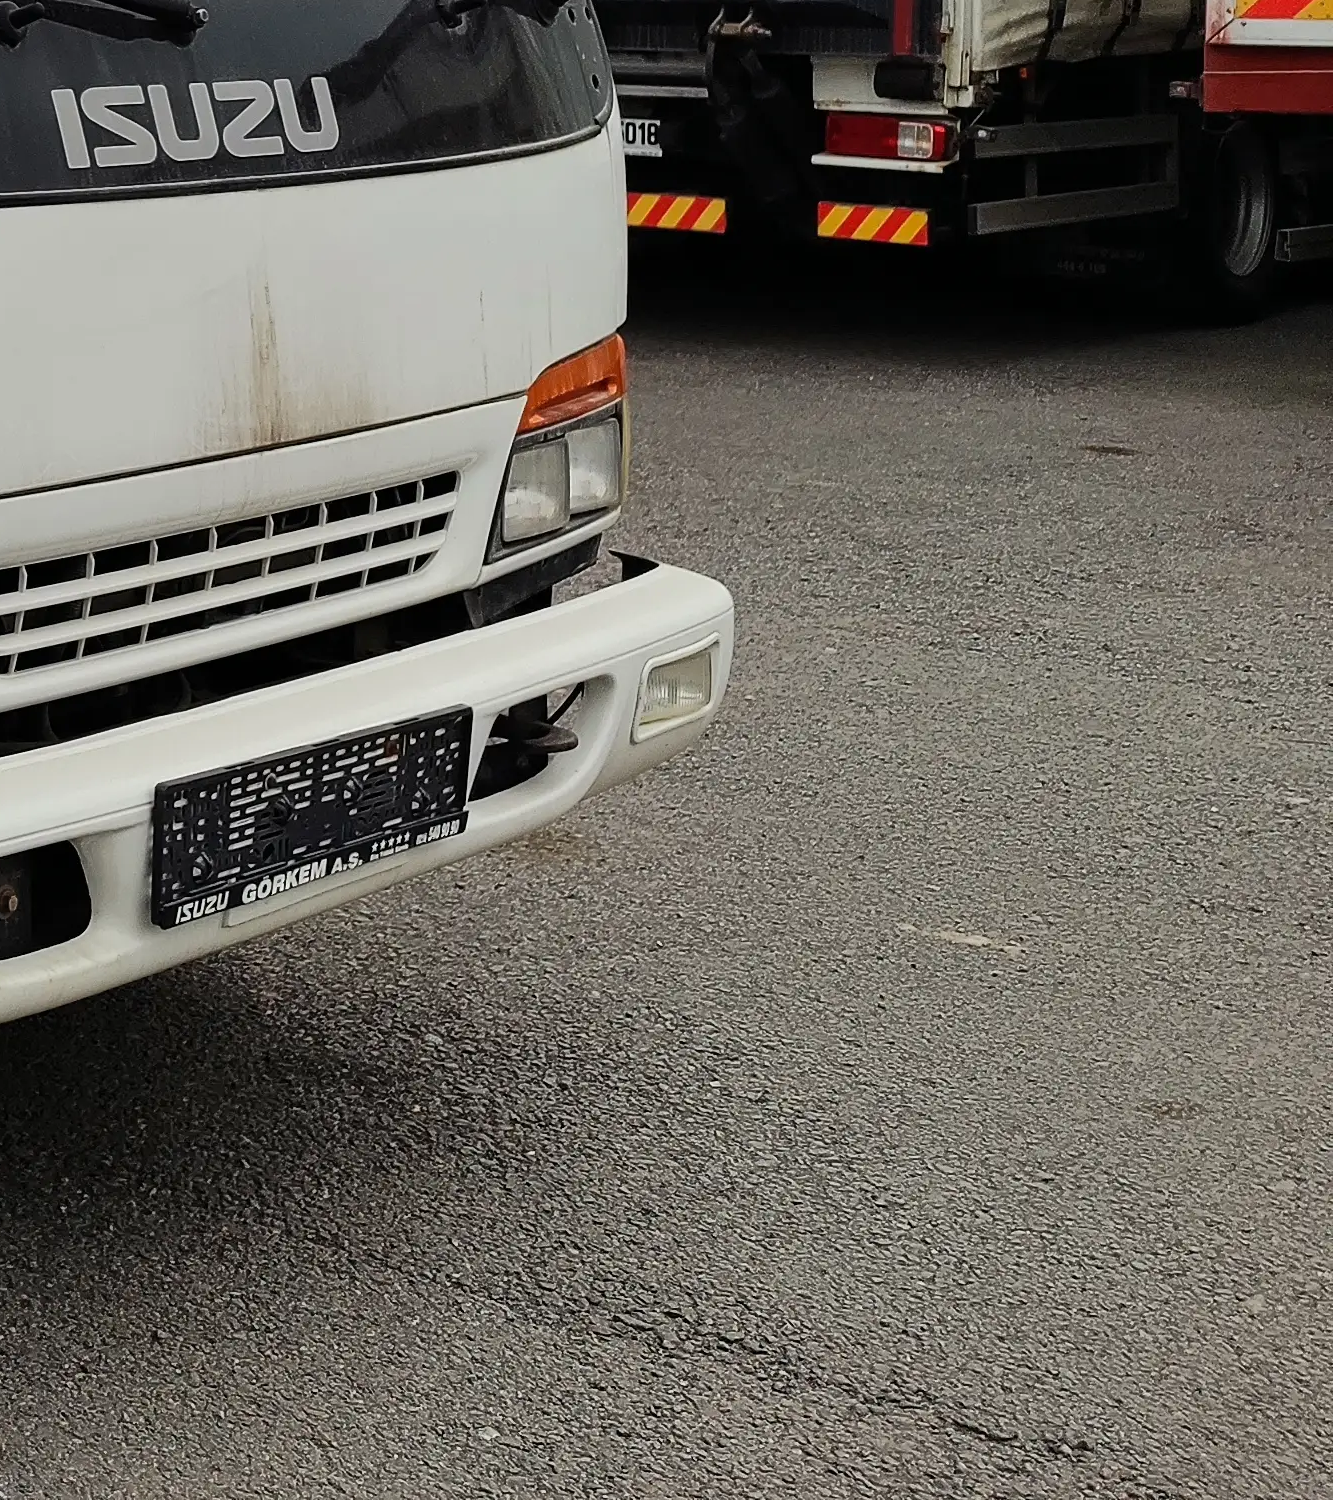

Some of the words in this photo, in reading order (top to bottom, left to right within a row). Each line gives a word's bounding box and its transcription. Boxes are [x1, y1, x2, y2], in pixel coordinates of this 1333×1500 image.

[50, 76, 340, 170] ISUZU
[621, 120, 659, 146] 018
[175, 890, 230, 925] ISUZU
[241, 857, 328, 905] GÖRKEM
